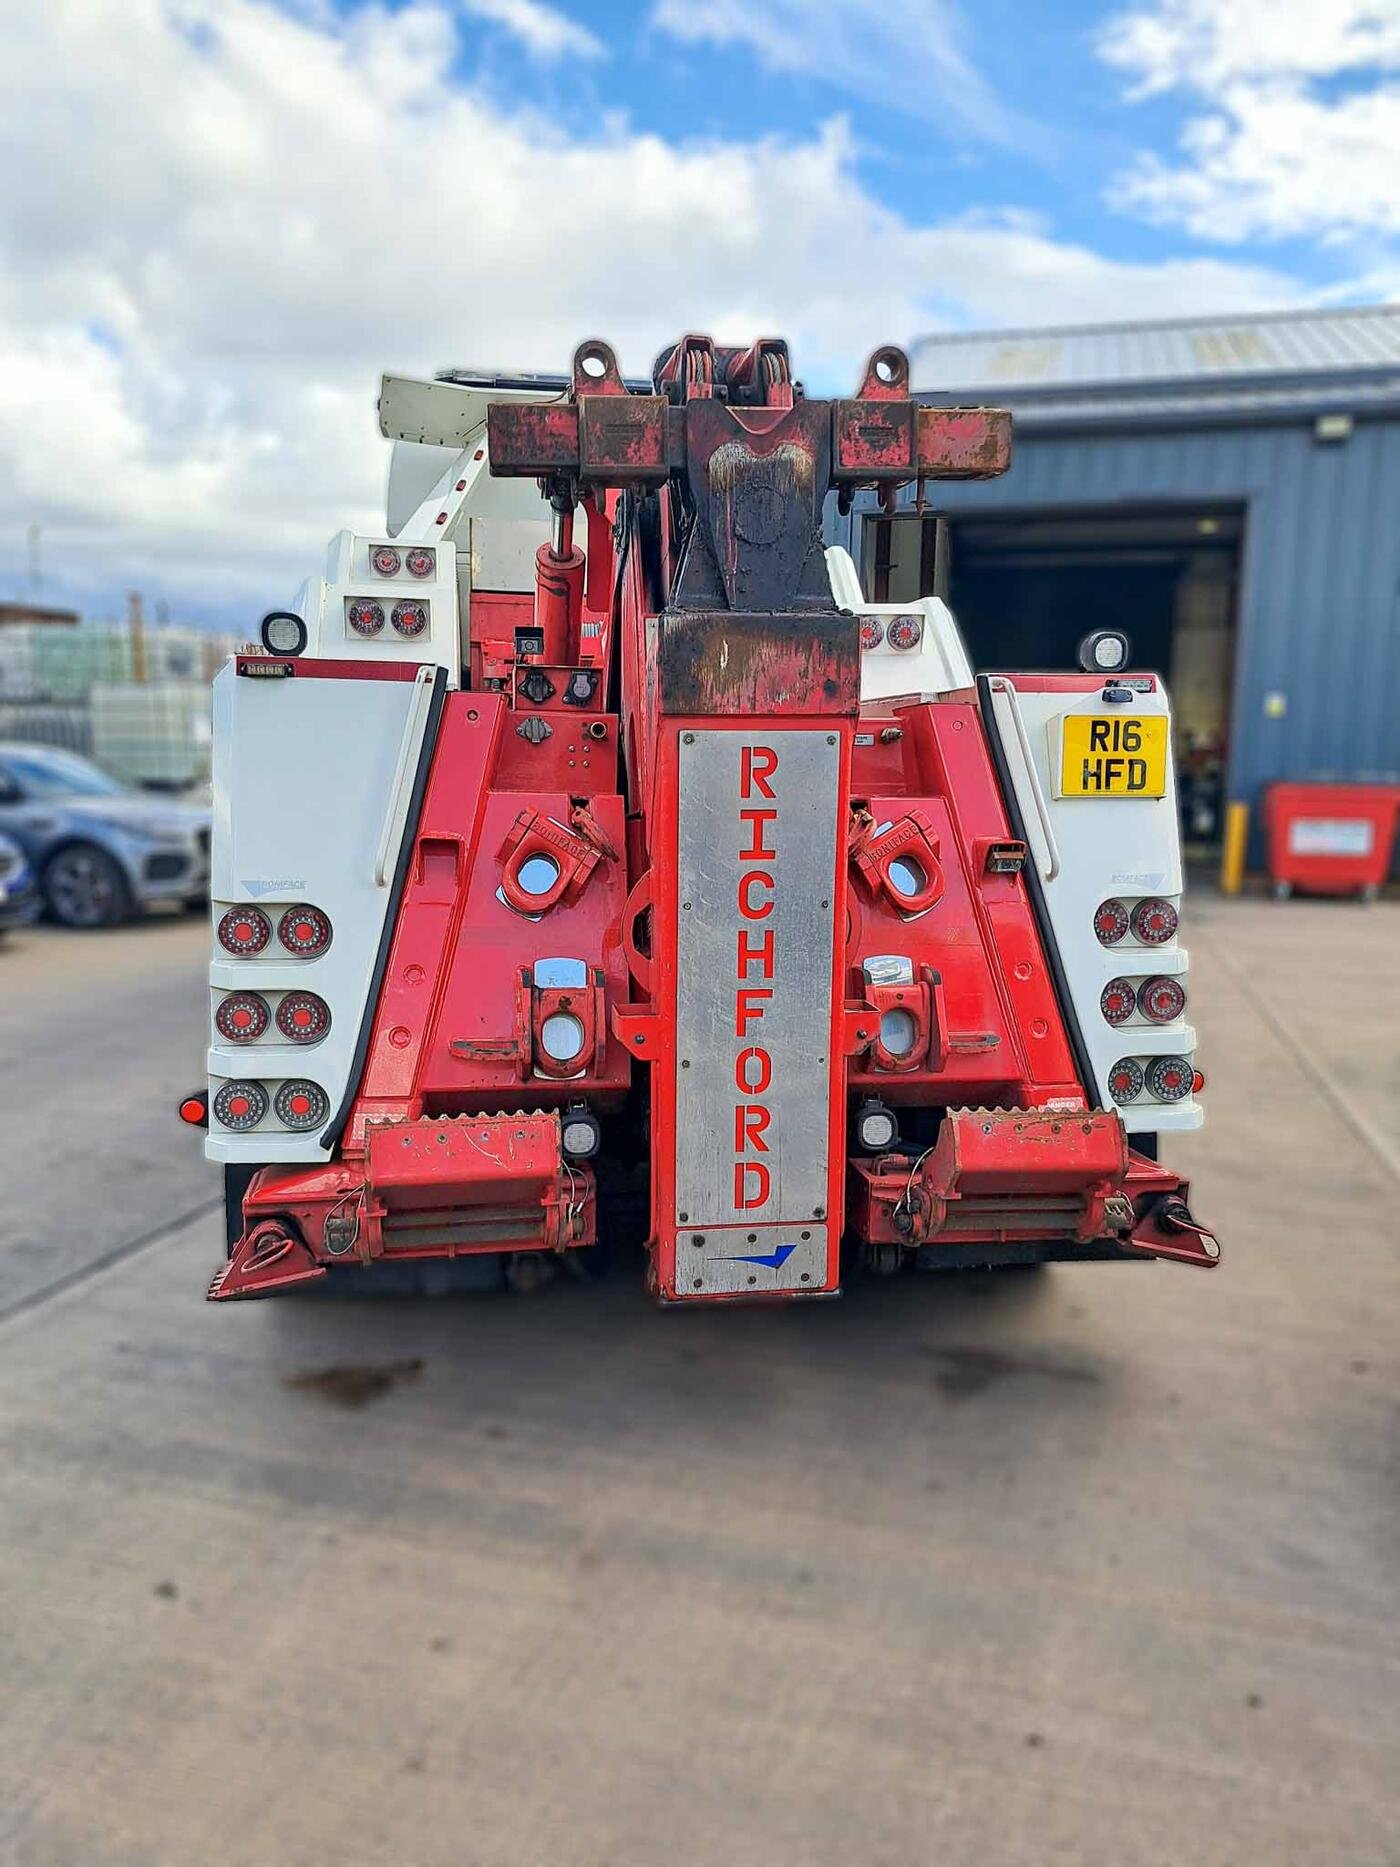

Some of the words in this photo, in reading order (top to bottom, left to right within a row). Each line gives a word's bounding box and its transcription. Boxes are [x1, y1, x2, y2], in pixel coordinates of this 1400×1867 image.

[1090, 720, 1143, 751] R16
[1082, 758, 1147, 790] HFD
[734, 746, 778, 1210] RICHFORD
